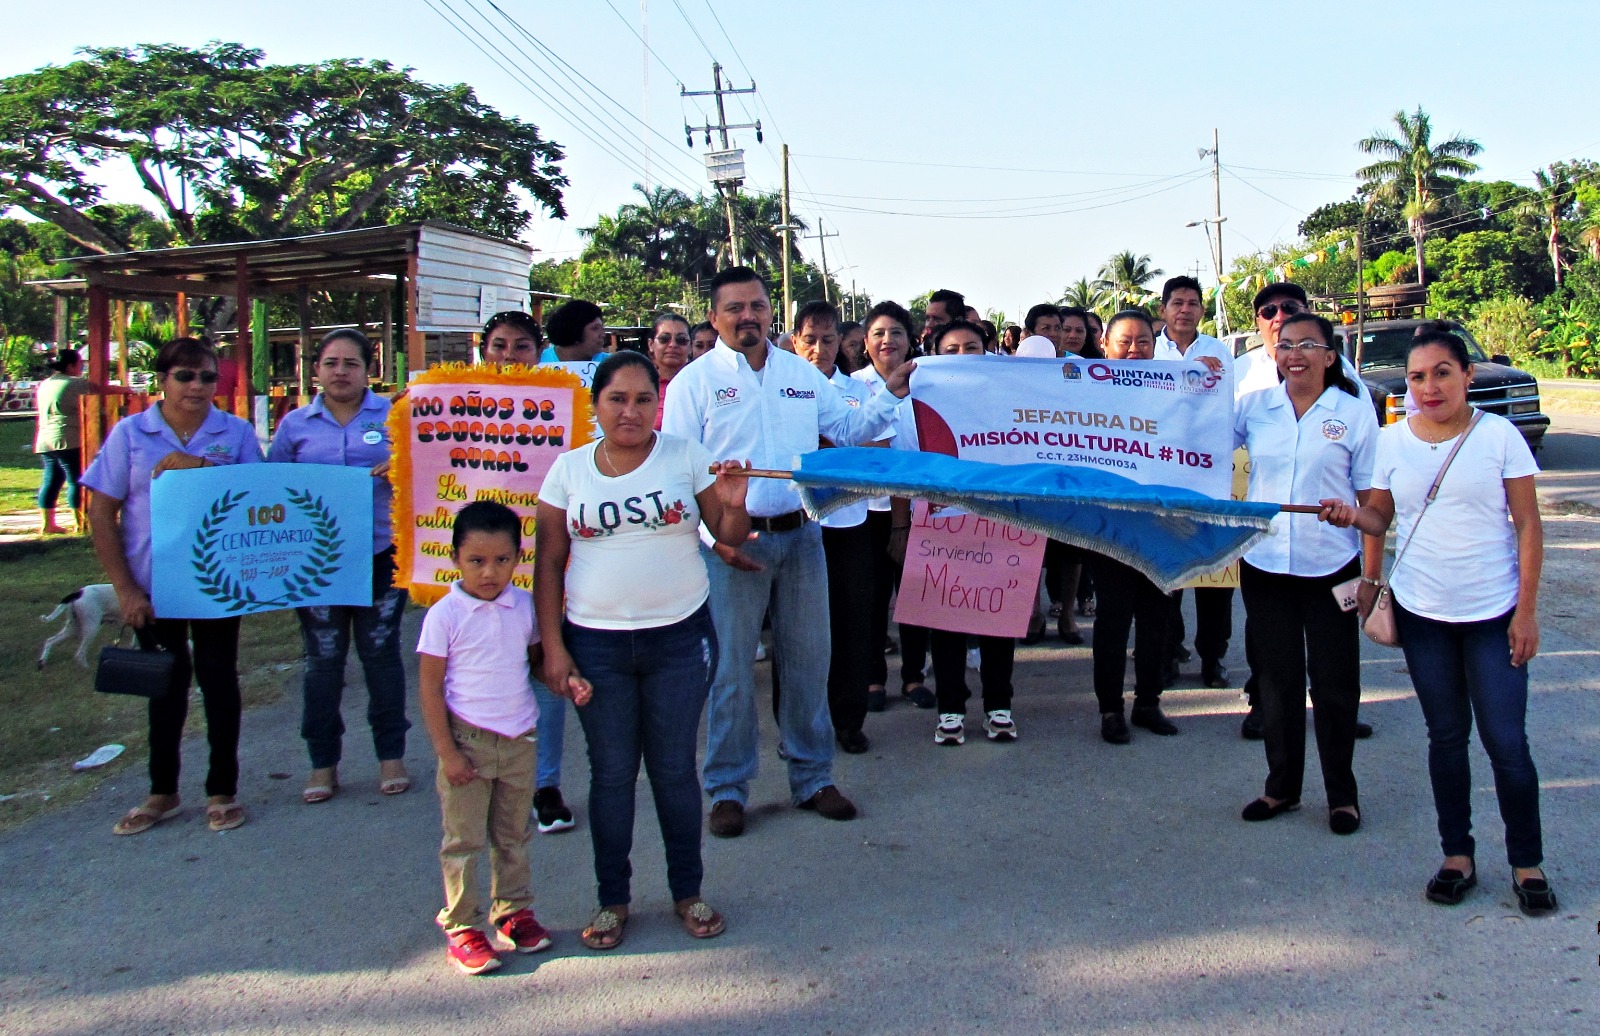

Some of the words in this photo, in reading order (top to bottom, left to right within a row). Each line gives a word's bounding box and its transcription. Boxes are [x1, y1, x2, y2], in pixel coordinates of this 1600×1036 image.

[1087, 363, 1174, 381] QUINTANA
[1112, 377, 1143, 387] ROO
[411, 396, 444, 418] 100
[450, 390, 515, 420] AÑOS
[522, 399, 555, 421] DE
[417, 421, 565, 446] EDUCACION
[1012, 408, 1126, 431] JEFATURA
[1129, 416, 1159, 435] DE
[960, 428, 1040, 448] MISIÓN
[1043, 433, 1154, 459] CULTURAL
[1036, 451, 1066, 461] C.C.T.
[450, 447, 529, 472] RURAL
[437, 474, 468, 501] Las
[475, 488, 538, 506] misione
[247, 503, 286, 526] 100
[579, 490, 664, 530] LOST
[221, 529, 313, 551] CENTENARIO
[421, 541, 454, 558] año
[918, 539, 993, 565] Sirviendo
[1006, 554, 1020, 567] a
